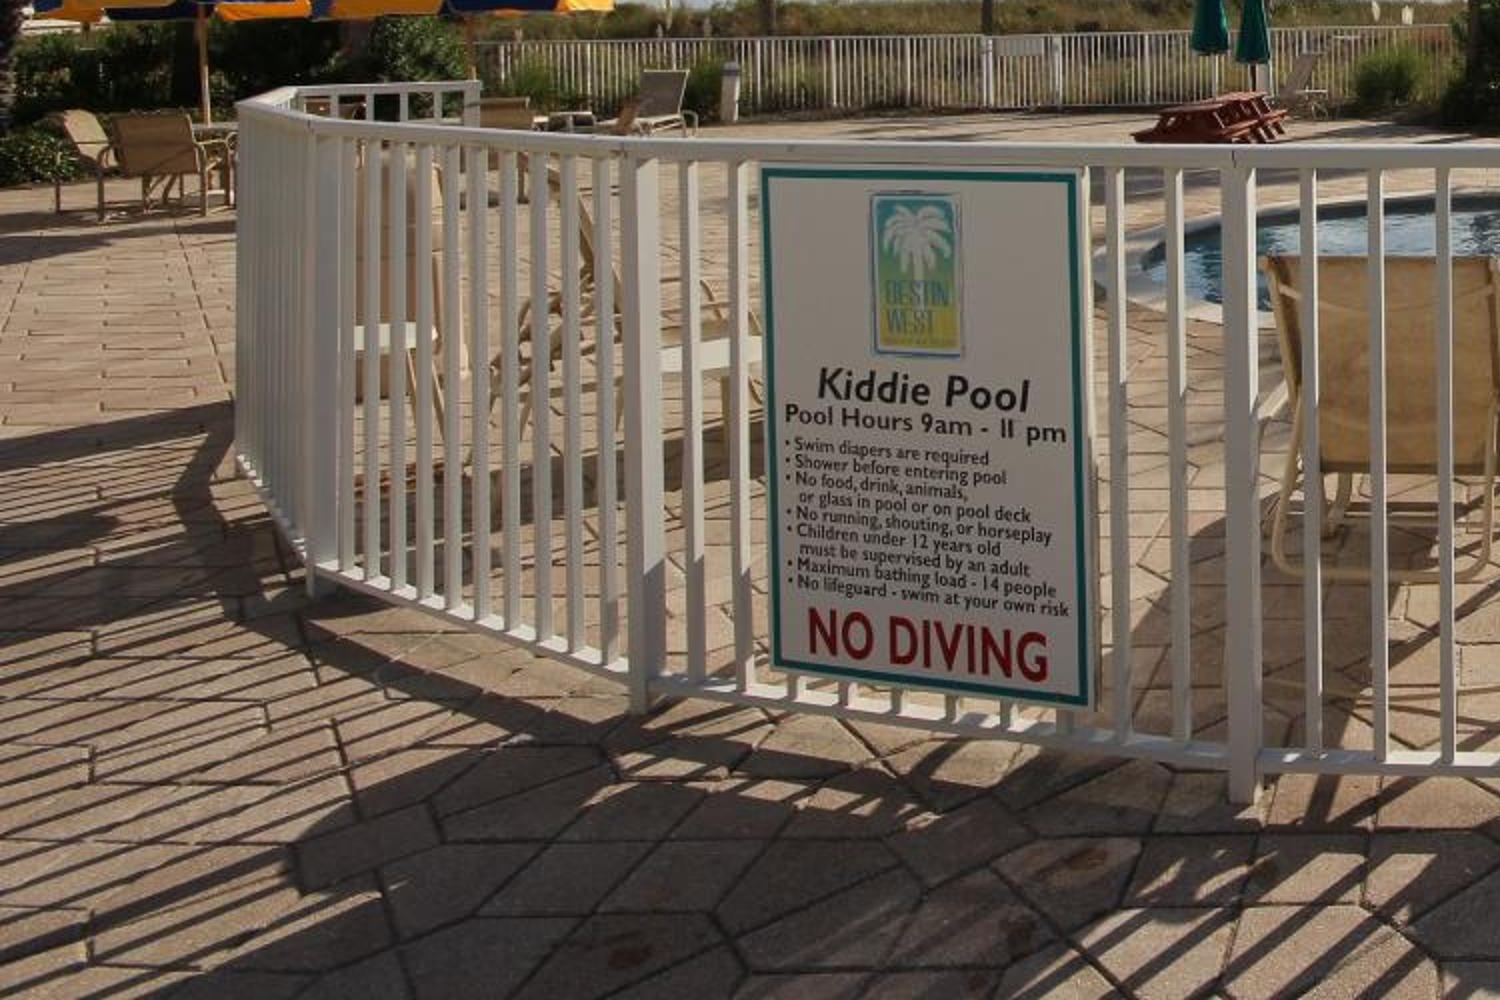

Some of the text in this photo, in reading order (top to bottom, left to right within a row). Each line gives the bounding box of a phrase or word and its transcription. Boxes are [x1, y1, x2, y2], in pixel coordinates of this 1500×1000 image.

[886, 310, 936, 335] WEST
[818, 367, 1030, 413] Kiddie Pool
[785, 403, 833, 425] Pool
[841, 407, 913, 431] Hours
[921, 413, 972, 436] 9am
[1027, 426, 1067, 447] pm
[794, 437, 989, 468] Swim diapers are required
[795, 453, 1007, 487] Shower before entering pool
[795, 471, 968, 501] No food, drink, animals,
[800, 491, 1031, 523] or glass in pool or on pool deck
[797, 505, 818, 520] No
[886, 514, 953, 537] shouting,
[956, 523, 974, 536] or
[978, 522, 1052, 547] horseplay
[797, 523, 1001, 556] Children under 12 years old
[800, 543, 1031, 577] must be supervised by an adult
[797, 557, 870, 578] Maximum
[874, 564, 930, 589] bathing
[935, 570, 967, 588] load
[983, 575, 999, 592] 14
[1003, 580, 1057, 600] people
[797, 573, 819, 591] No
[824, 576, 887, 599] lifeguard
[902, 588, 940, 603] swim
[945, 593, 960, 605] at
[964, 596, 999, 611] your
[1003, 600, 1035, 613] own
[1040, 600, 1069, 617] risk
[807, 606, 1048, 683] NO DIVING
